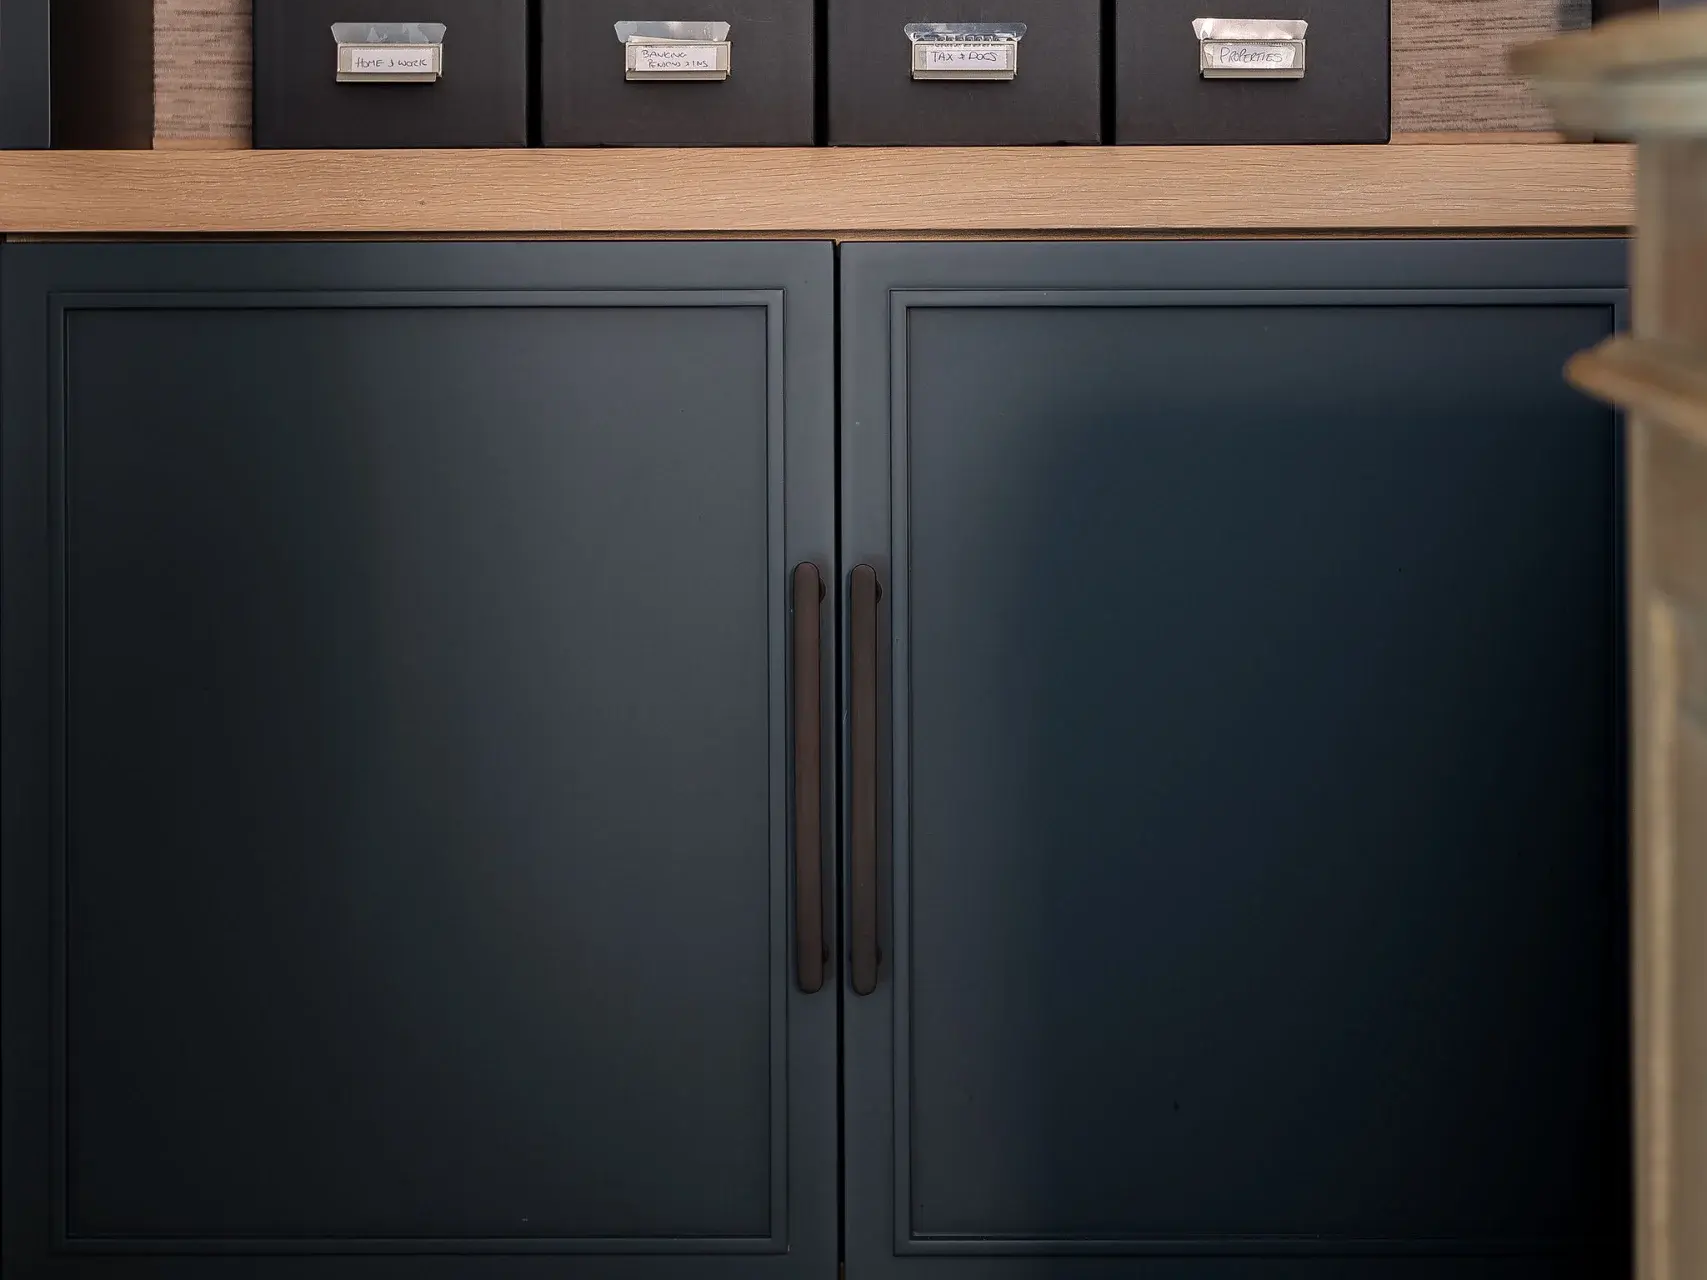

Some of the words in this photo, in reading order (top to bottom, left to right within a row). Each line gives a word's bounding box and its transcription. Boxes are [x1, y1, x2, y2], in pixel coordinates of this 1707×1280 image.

[931, 52, 953, 62] TAX
[969, 52, 998, 61] DOCS
[1220, 47, 1282, 63] PROPERTIES
[355, 57, 384, 68] HOME
